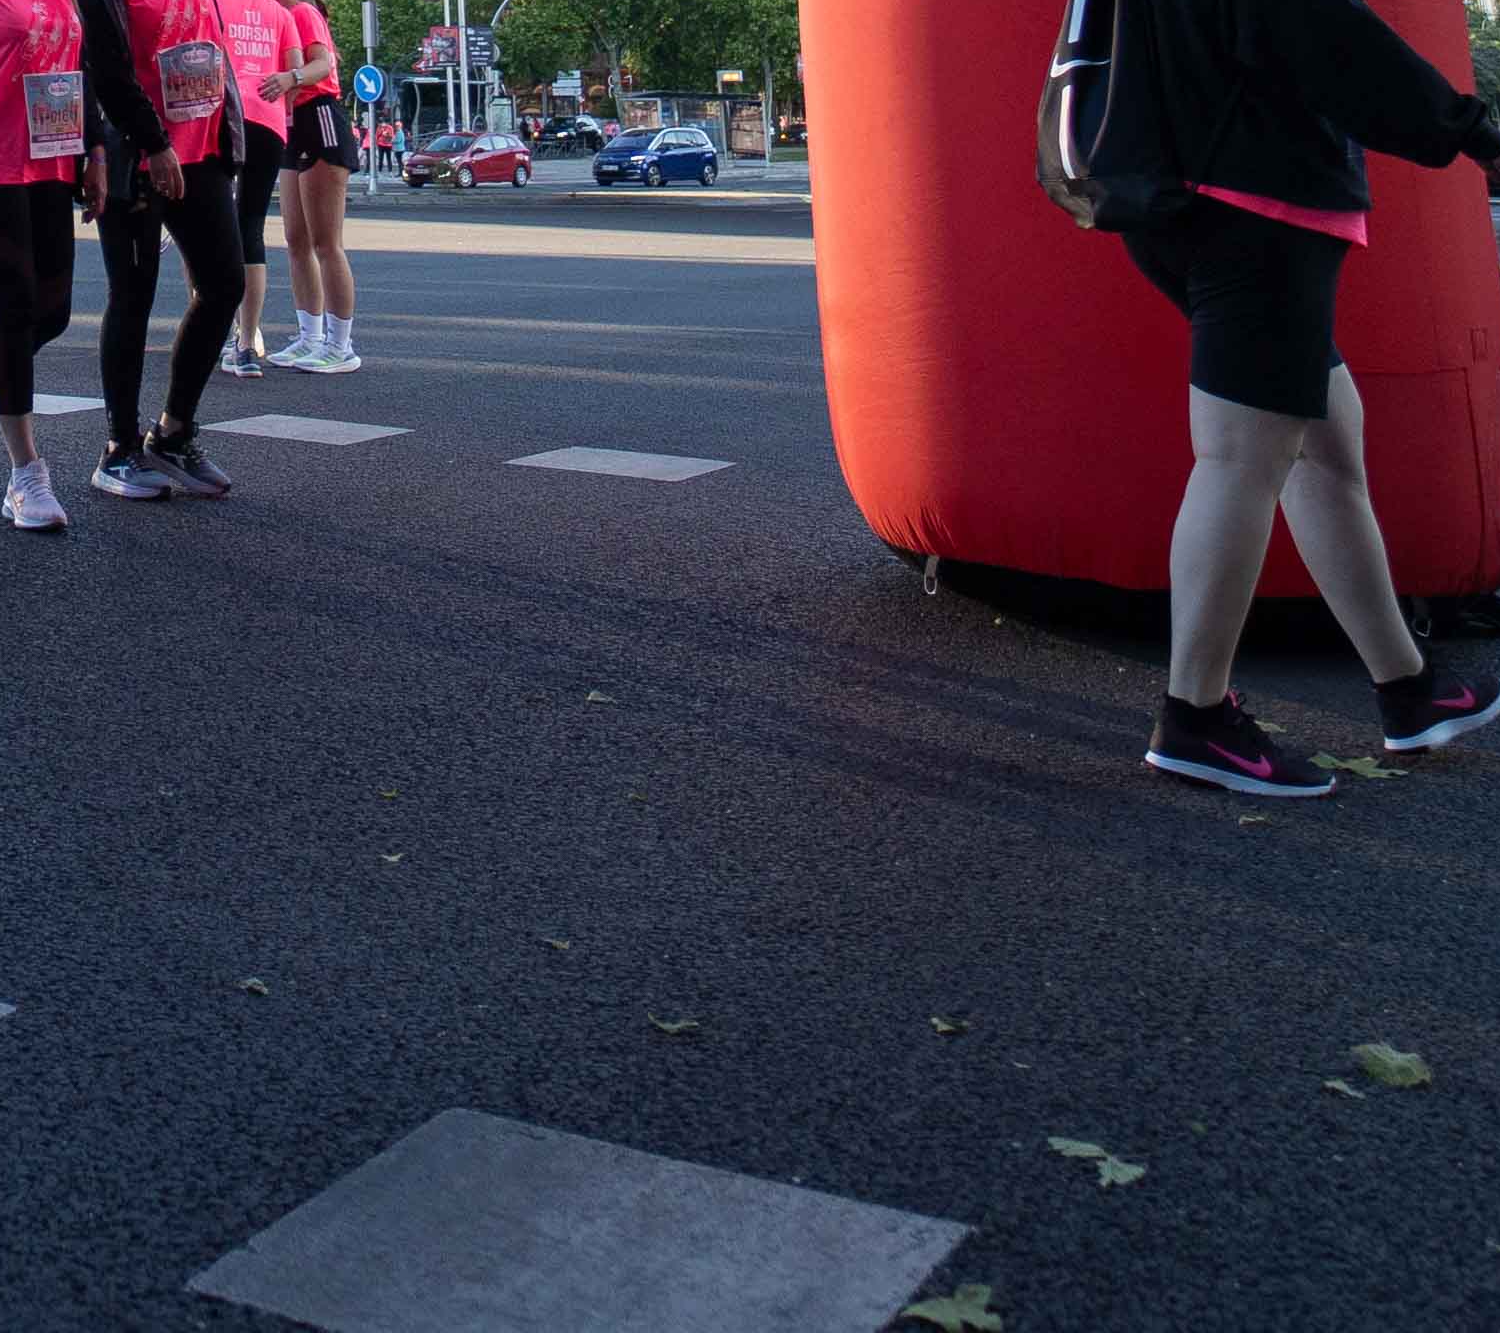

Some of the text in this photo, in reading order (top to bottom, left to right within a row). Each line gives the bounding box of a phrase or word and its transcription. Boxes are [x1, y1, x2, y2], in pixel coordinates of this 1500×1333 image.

[244, 10, 261, 25] TU
[228, 23, 277, 44] DORSAL
[234, 40, 272, 59] SUMA
